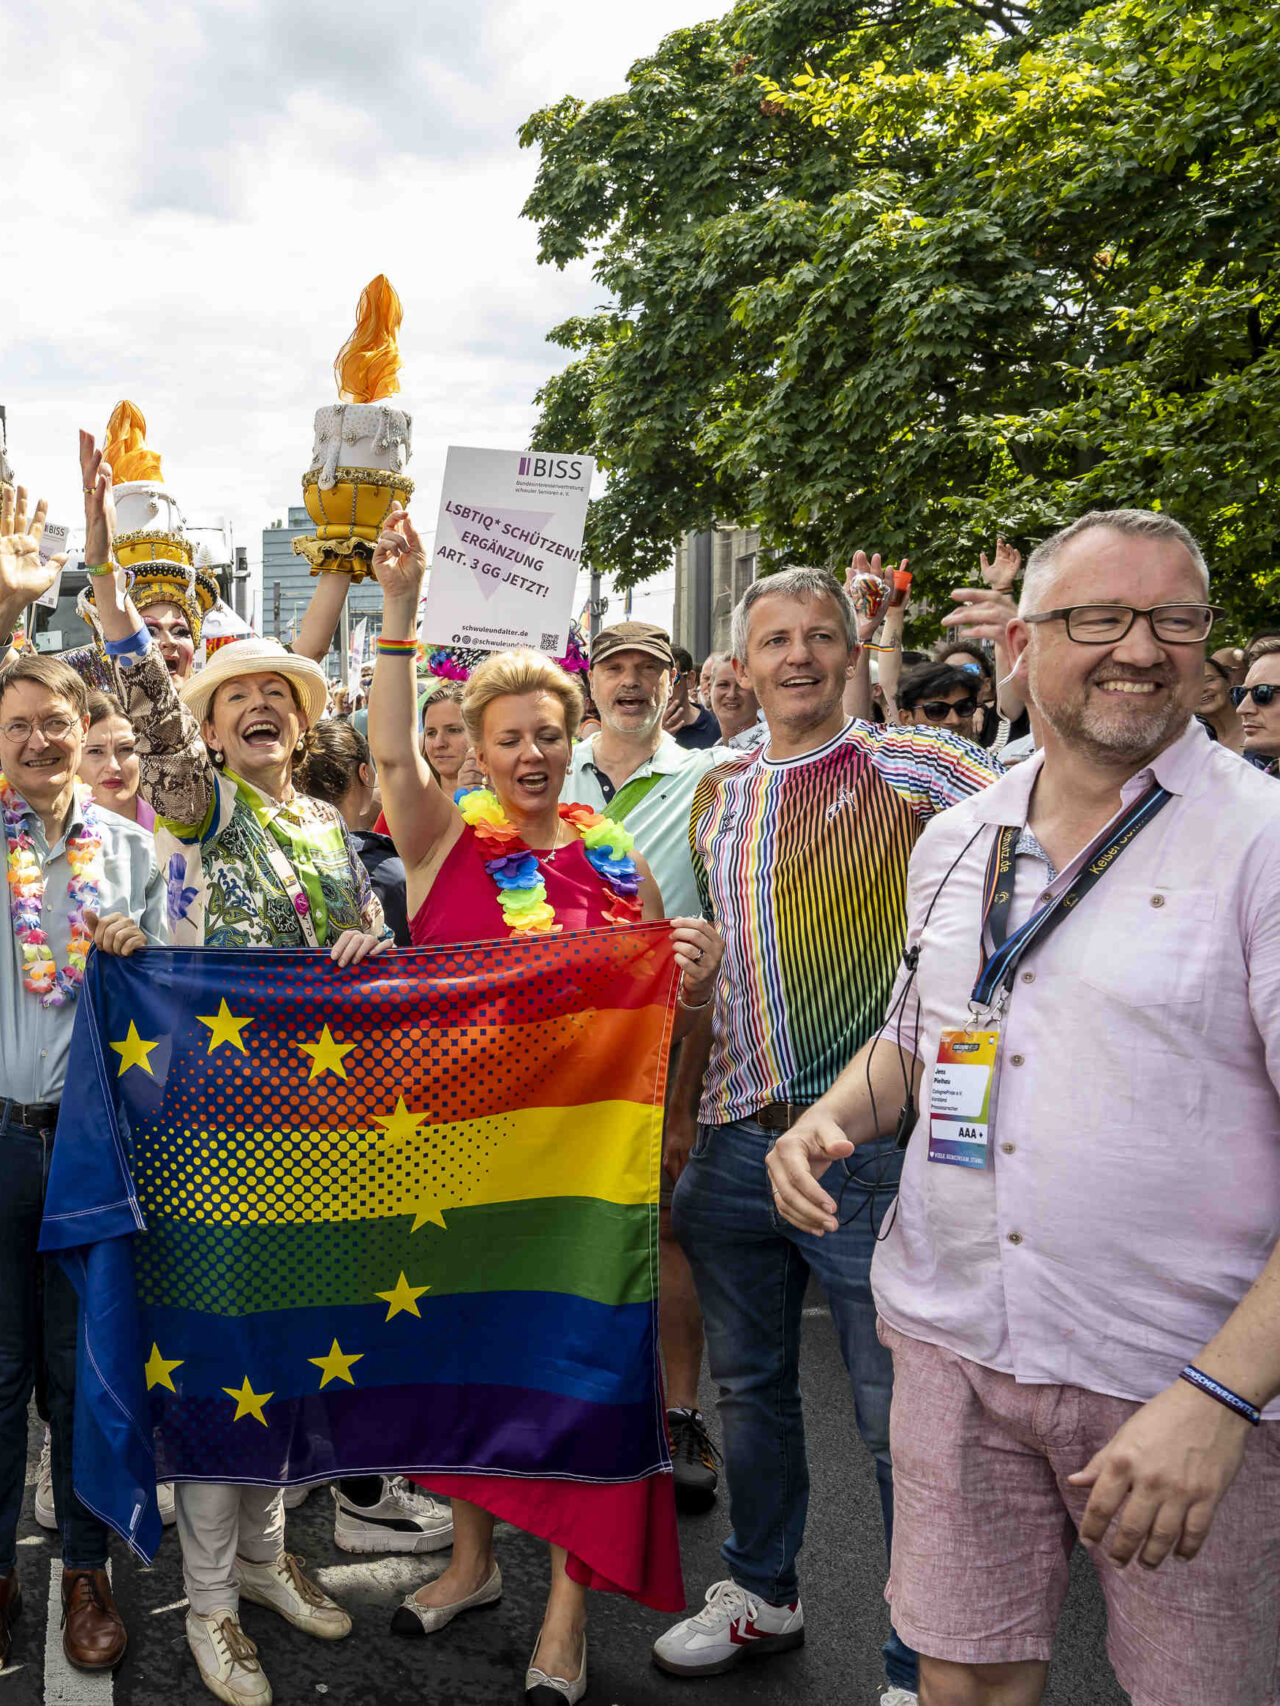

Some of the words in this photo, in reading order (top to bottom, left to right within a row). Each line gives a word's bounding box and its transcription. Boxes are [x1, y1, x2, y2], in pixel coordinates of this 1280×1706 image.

[533, 458, 583, 480] BISS
[48, 526, 65, 537] BISS
[501, 523, 580, 562] SCHÜTZEN!
[461, 530, 545, 572] ERGÄNZUNG
[436, 545, 467, 566] ART.
[470, 558, 479, 570] 3
[481, 562, 501, 578] GG
[501, 571, 550, 598] JETZT!
[462, 624, 529, 637] schwuleundalter.de
[958, 1127, 977, 1139] AAA
